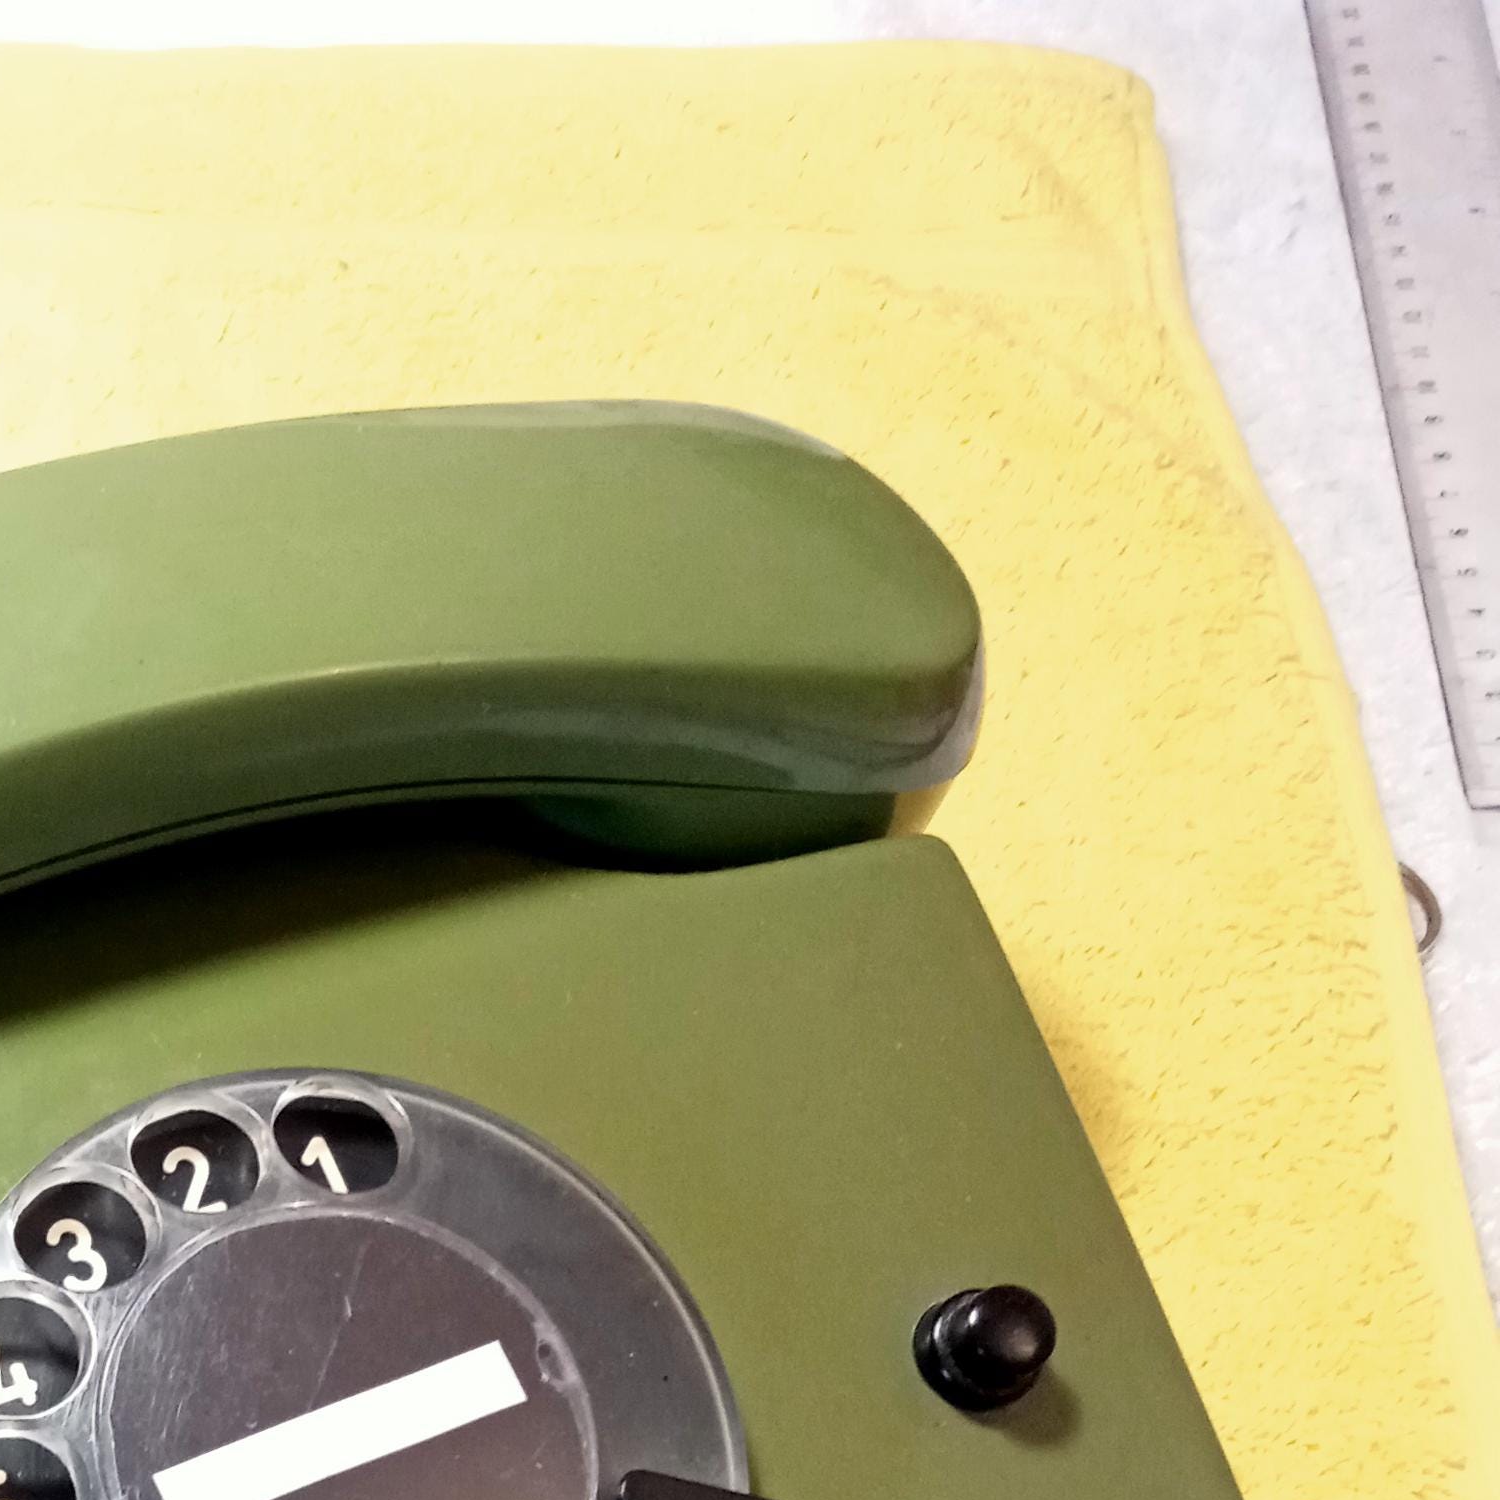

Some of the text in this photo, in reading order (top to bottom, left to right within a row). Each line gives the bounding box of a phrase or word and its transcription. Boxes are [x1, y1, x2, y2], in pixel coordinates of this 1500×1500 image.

[163, 1146, 227, 1214] 2
[301, 1136, 348, 1195] 1
[46, 1219, 108, 1292] 3
